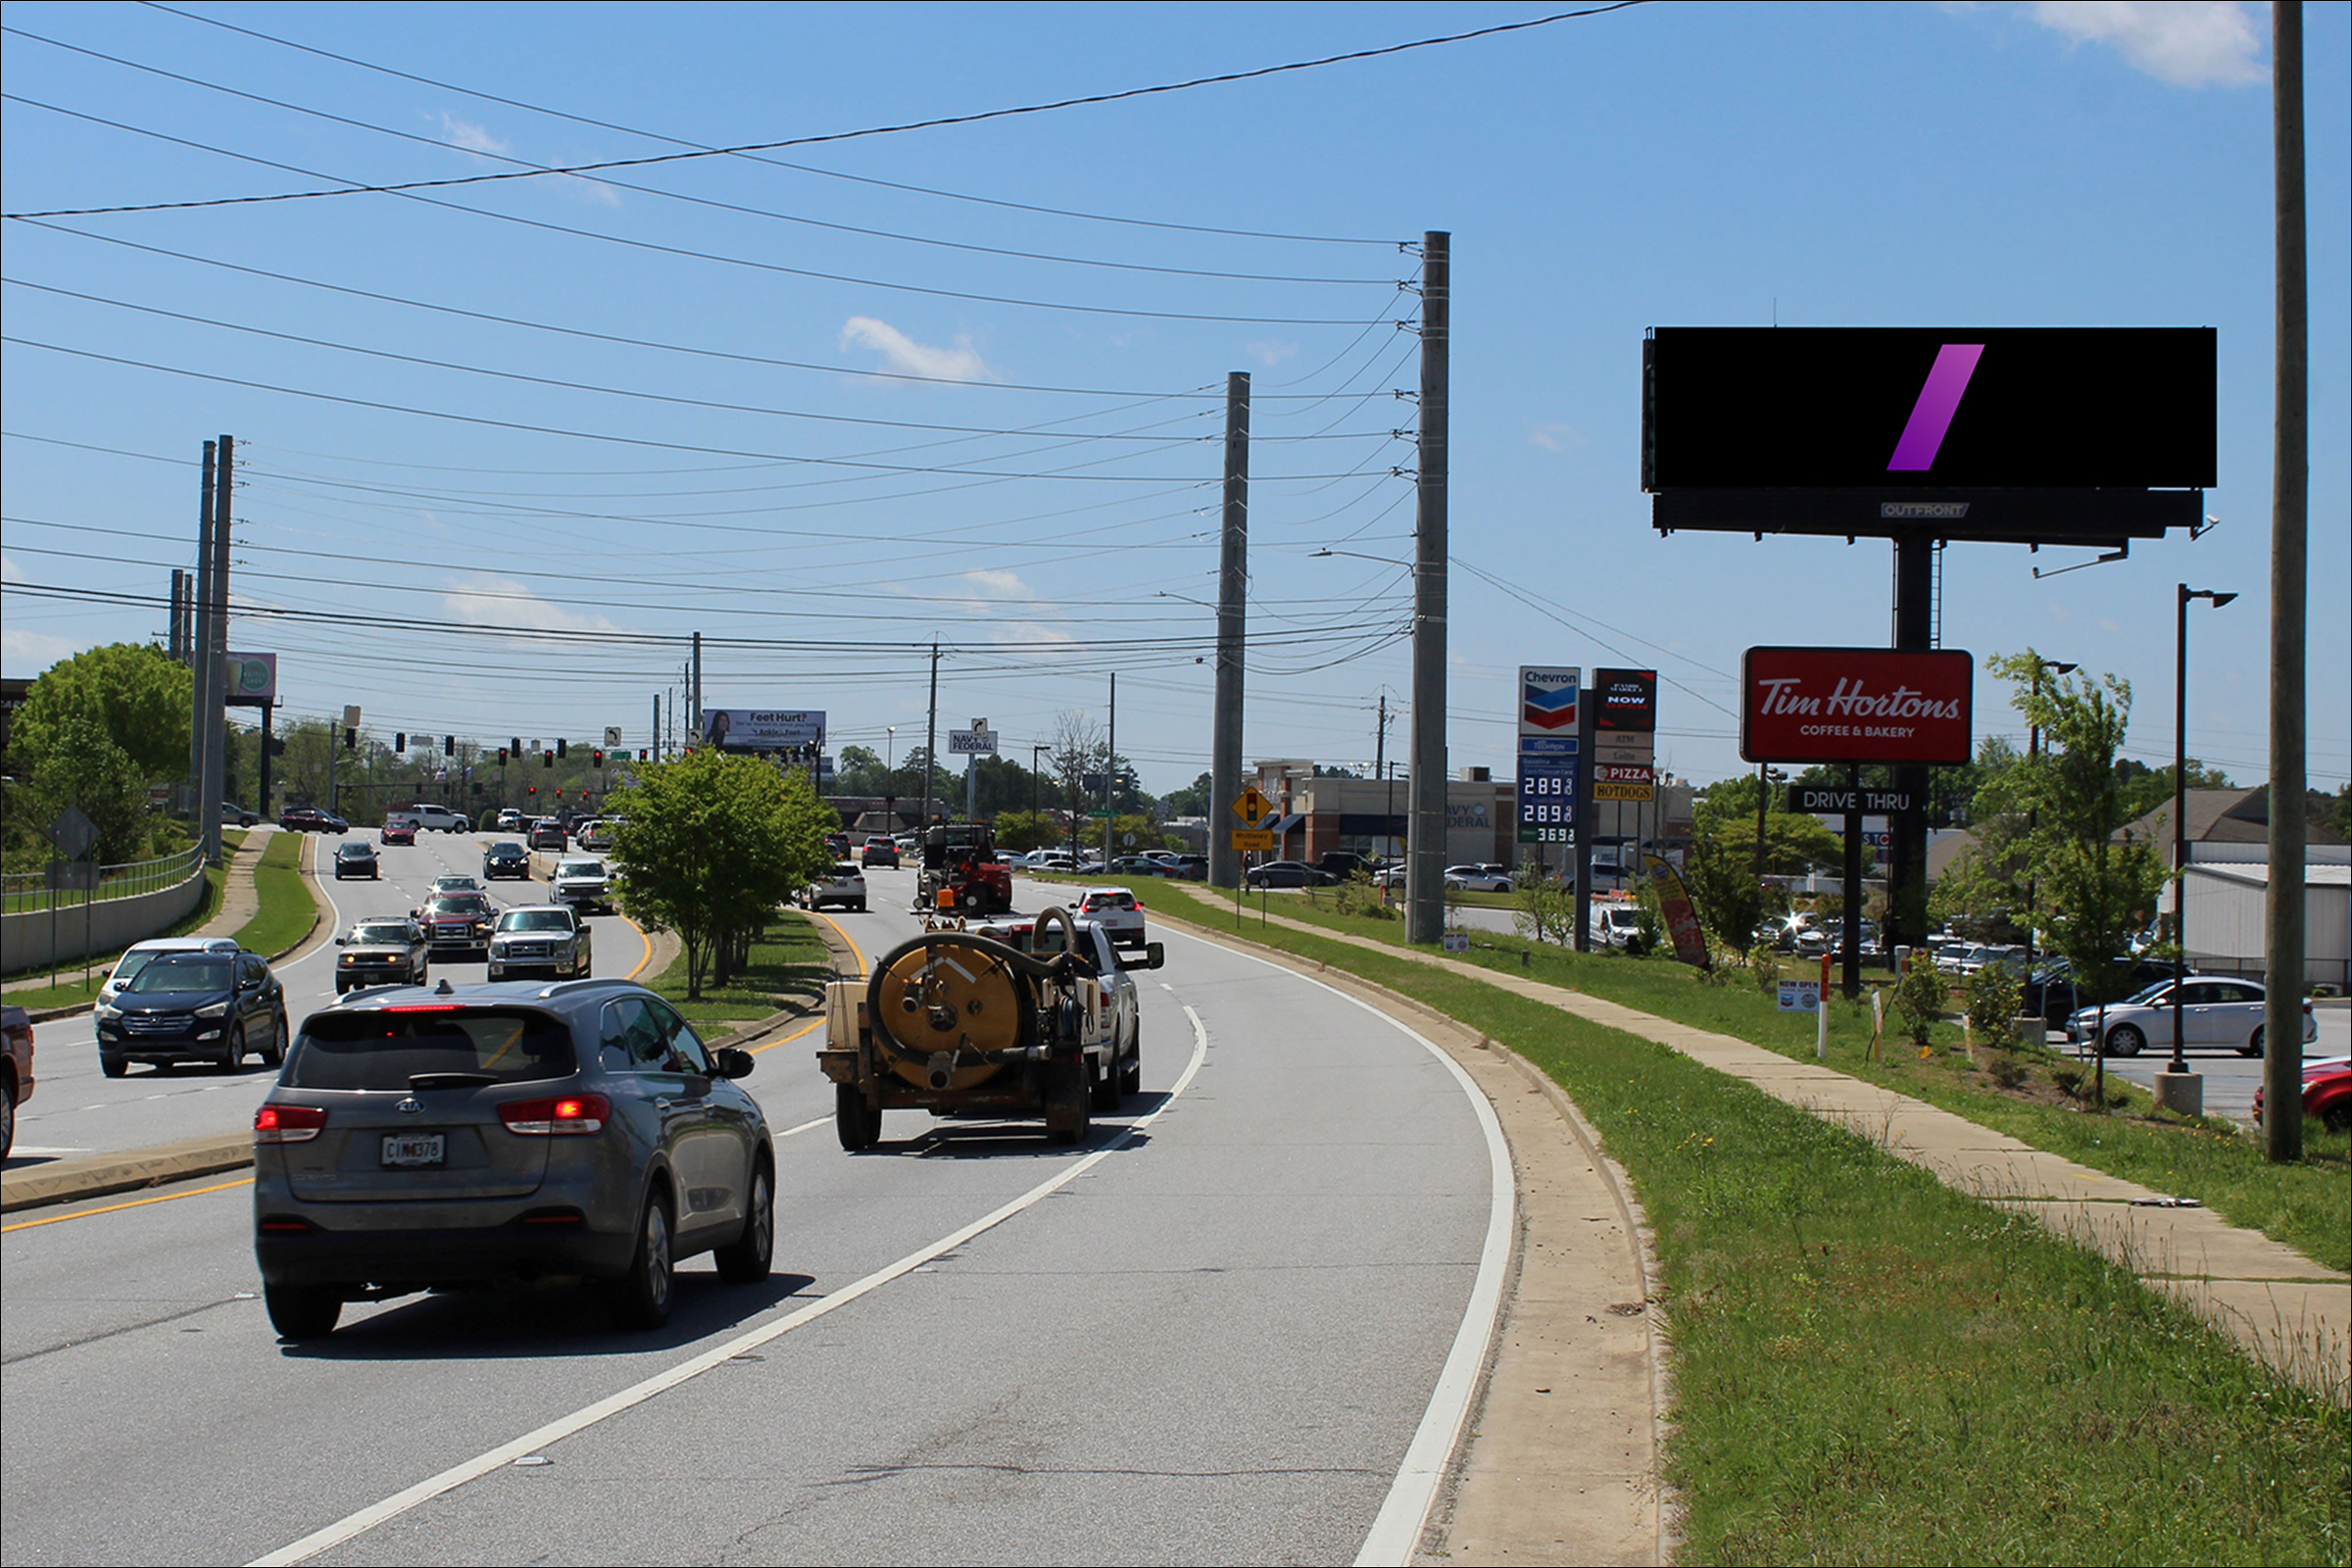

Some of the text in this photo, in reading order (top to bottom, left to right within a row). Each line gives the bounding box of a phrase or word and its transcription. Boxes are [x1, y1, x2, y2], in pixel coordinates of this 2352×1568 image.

[1885, 505, 1962, 515] OUTFRONT
[1525, 670, 1577, 683] Chevron
[1759, 677, 1959, 719] Tim Hortons
[750, 712, 808, 722] Feet Hurt?
[1800, 724, 1915, 737] COFFEE & BAKERY
[1615, 734, 1636, 744] ATM
[954, 742, 994, 751] FEDERAL
[1610, 767, 1650, 780] PIZZA
[1596, 785, 1650, 799] HOTDOGS
[1804, 791, 1910, 810] DRIVE THRU
[1447, 816, 1491, 827] DERAL
[399, 1102, 421, 1111] KIA
